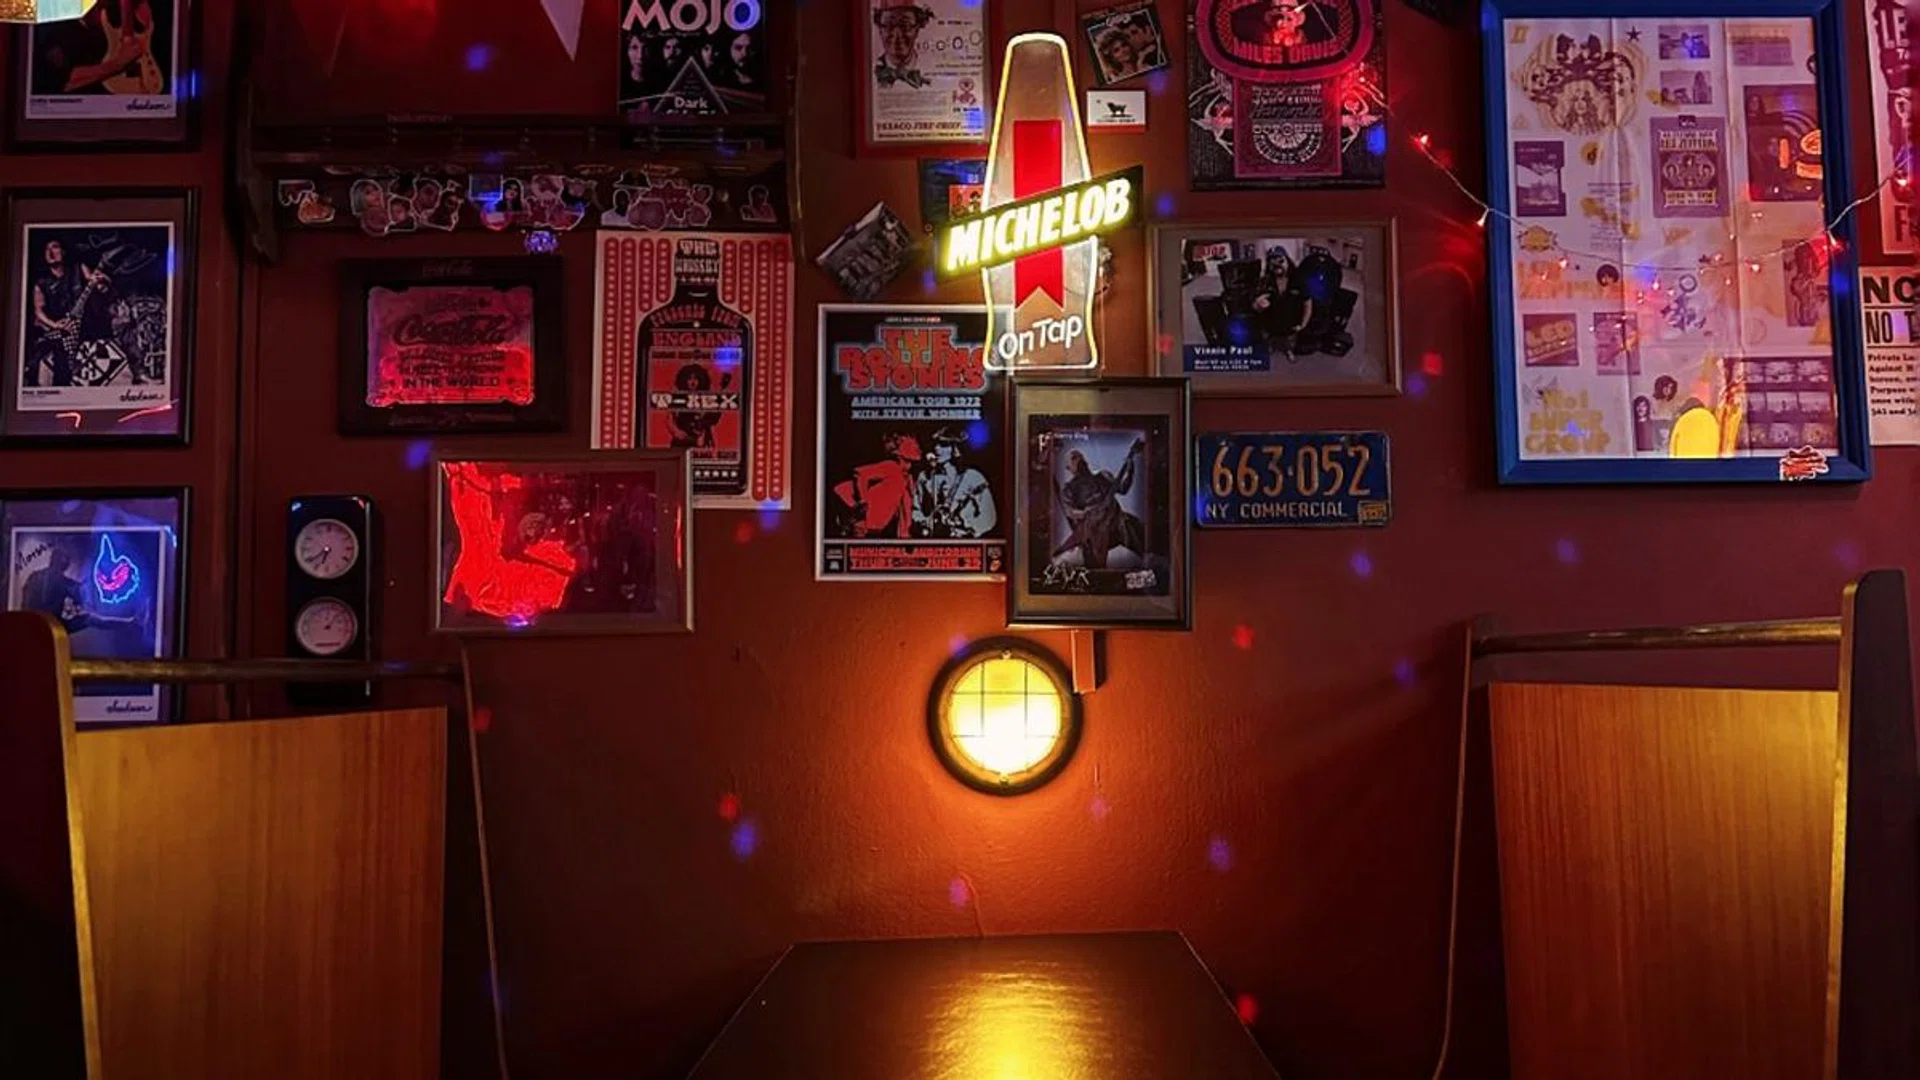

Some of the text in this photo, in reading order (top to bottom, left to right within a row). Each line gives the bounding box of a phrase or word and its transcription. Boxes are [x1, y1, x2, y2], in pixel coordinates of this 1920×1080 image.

[620, 0, 763, 34] MOJO
[1232, 38, 1341, 64] MILES DAVIS
[673, 95, 710, 109] Dark
[946, 177, 1131, 271] MICHELOB
[1033, 314, 1083, 348] Tap
[1865, 311, 1893, 343] NO
[652, 331, 742, 347] ENGLAND
[1229, 346, 1254, 355] Paul
[417, 378, 443, 388] THE
[446, 378, 501, 388] WORLD
[847, 366, 985, 391] STONES
[650, 393, 738, 410] T-REX
[851, 396, 981, 408] AMERICAN TOUR 1972
[851, 409, 981, 420] WITH STEVIE WONDER
[1205, 503, 1230, 519] NY
[1239, 501, 1349, 519] COMMERCIAL
[912, 547, 981, 558] AUDITORIUM
